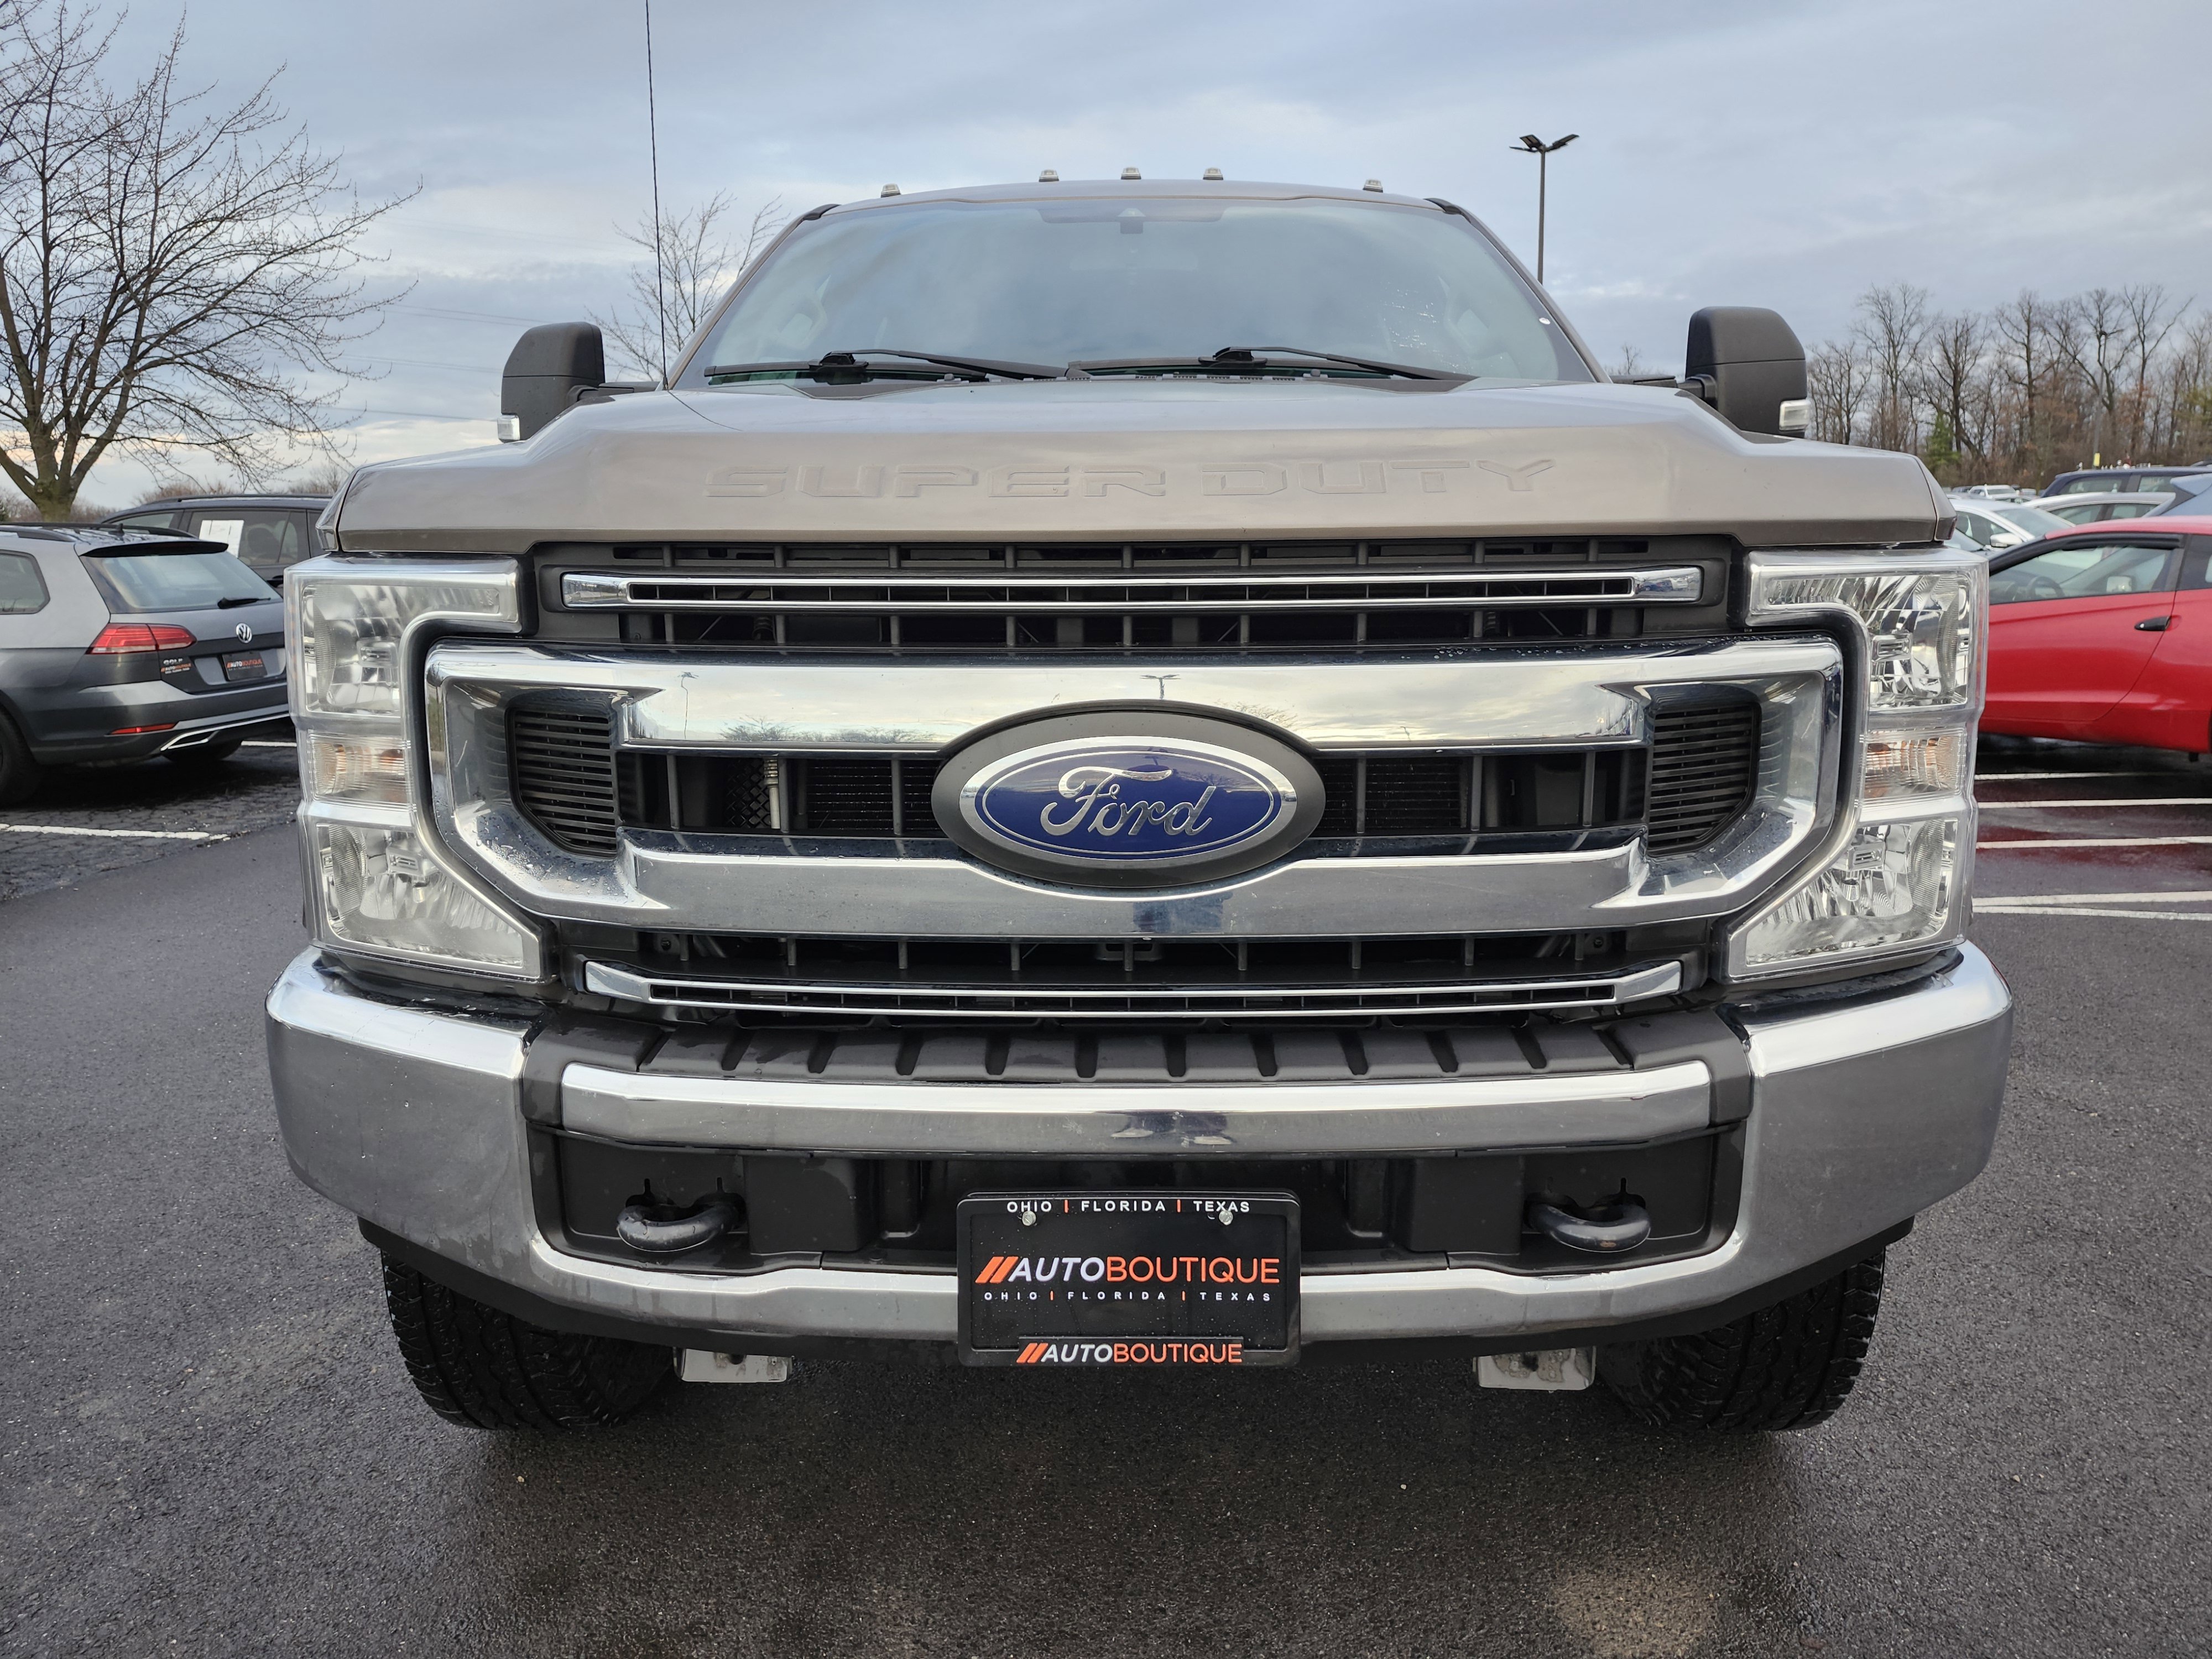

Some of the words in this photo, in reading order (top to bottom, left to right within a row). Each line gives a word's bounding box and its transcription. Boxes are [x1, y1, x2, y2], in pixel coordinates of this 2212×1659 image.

[705, 463, 1167, 499] SUPER
[1200, 458, 1557, 498] DUTY
[1041, 766, 1217, 836] Ford
[1006, 1201, 1052, 1213] OHIO
[1081, 1201, 1166, 1212] FLORIDA
[1193, 1201, 1250, 1213] TEXAS
[984, 1292, 1037, 1301] OHIO
[1067, 1291, 1166, 1301] FLORIDA
[1200, 1292, 1271, 1301] TEXAS
